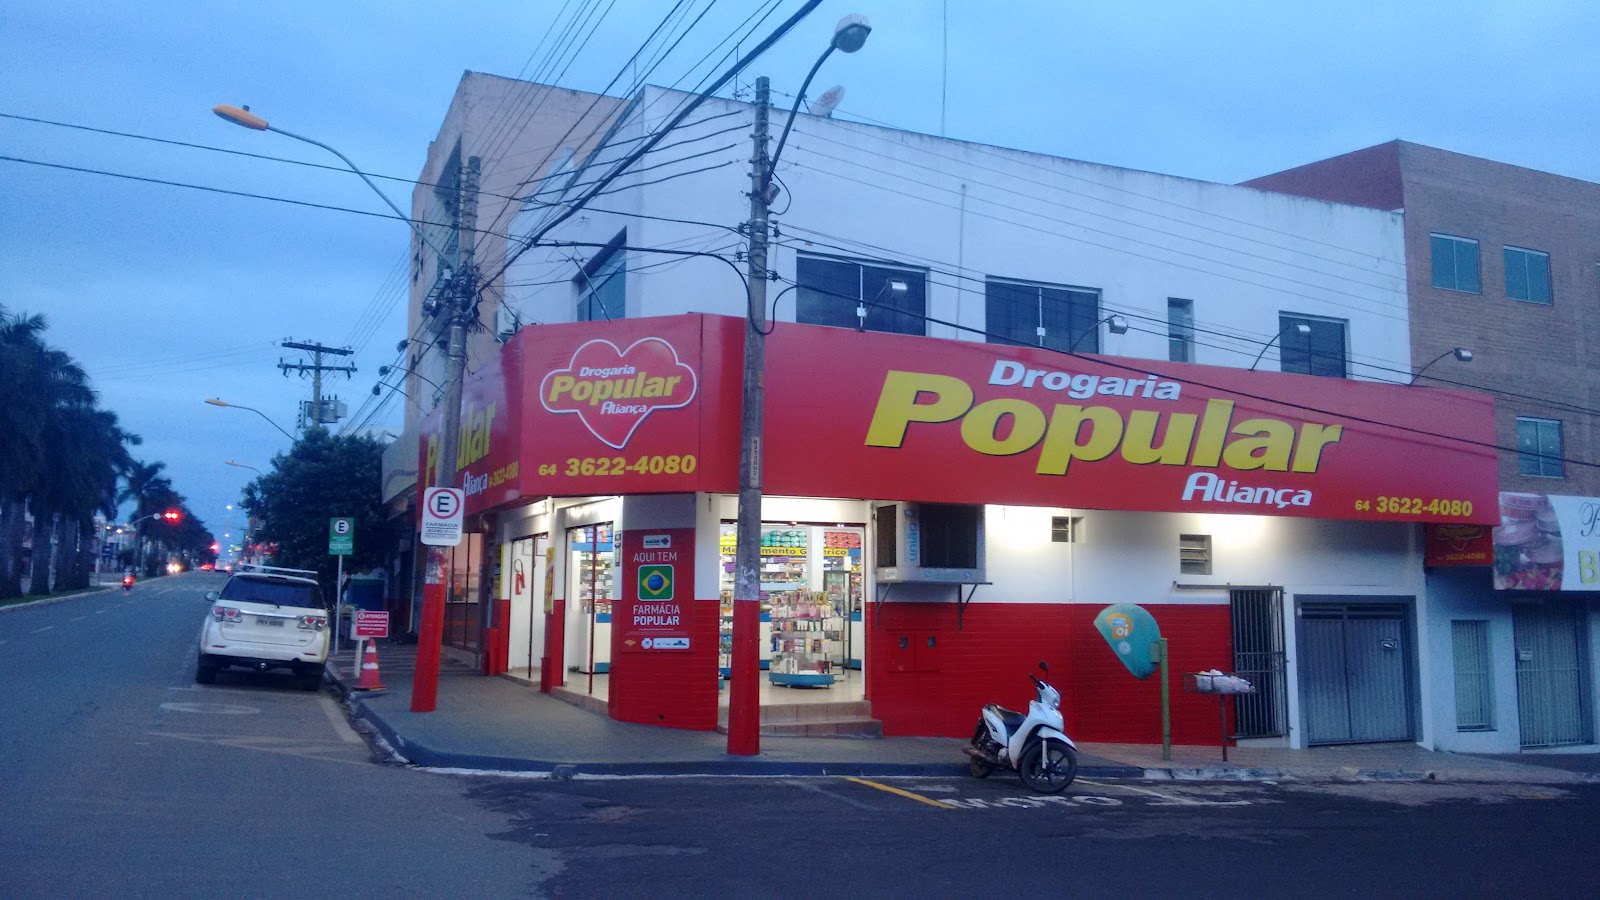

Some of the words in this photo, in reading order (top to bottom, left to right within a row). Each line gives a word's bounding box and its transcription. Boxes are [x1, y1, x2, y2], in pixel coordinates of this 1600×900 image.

[579, 364, 635, 378] Drogaria
[988, 359, 1182, 400] Drogaria
[549, 371, 681, 406] Popular
[600, 401, 647, 415] Aliança
[864, 369, 1344, 476] Popular
[538, 463, 557, 476] 64
[564, 454, 697, 477] 3622-4080
[463, 470, 488, 497] Aliança
[1181, 471, 1313, 509] Aliança
[437, 496, 450, 512] E
[1354, 499, 1371, 512] 64
[1376, 495, 1473, 517] 3622-4080
[338, 522, 345, 532] E
[633, 552, 655, 563] AQUI
[658, 552, 677, 562] TEM
[633, 603, 681, 615] FARMÁCIA
[633, 615, 680, 626] POPULAR
